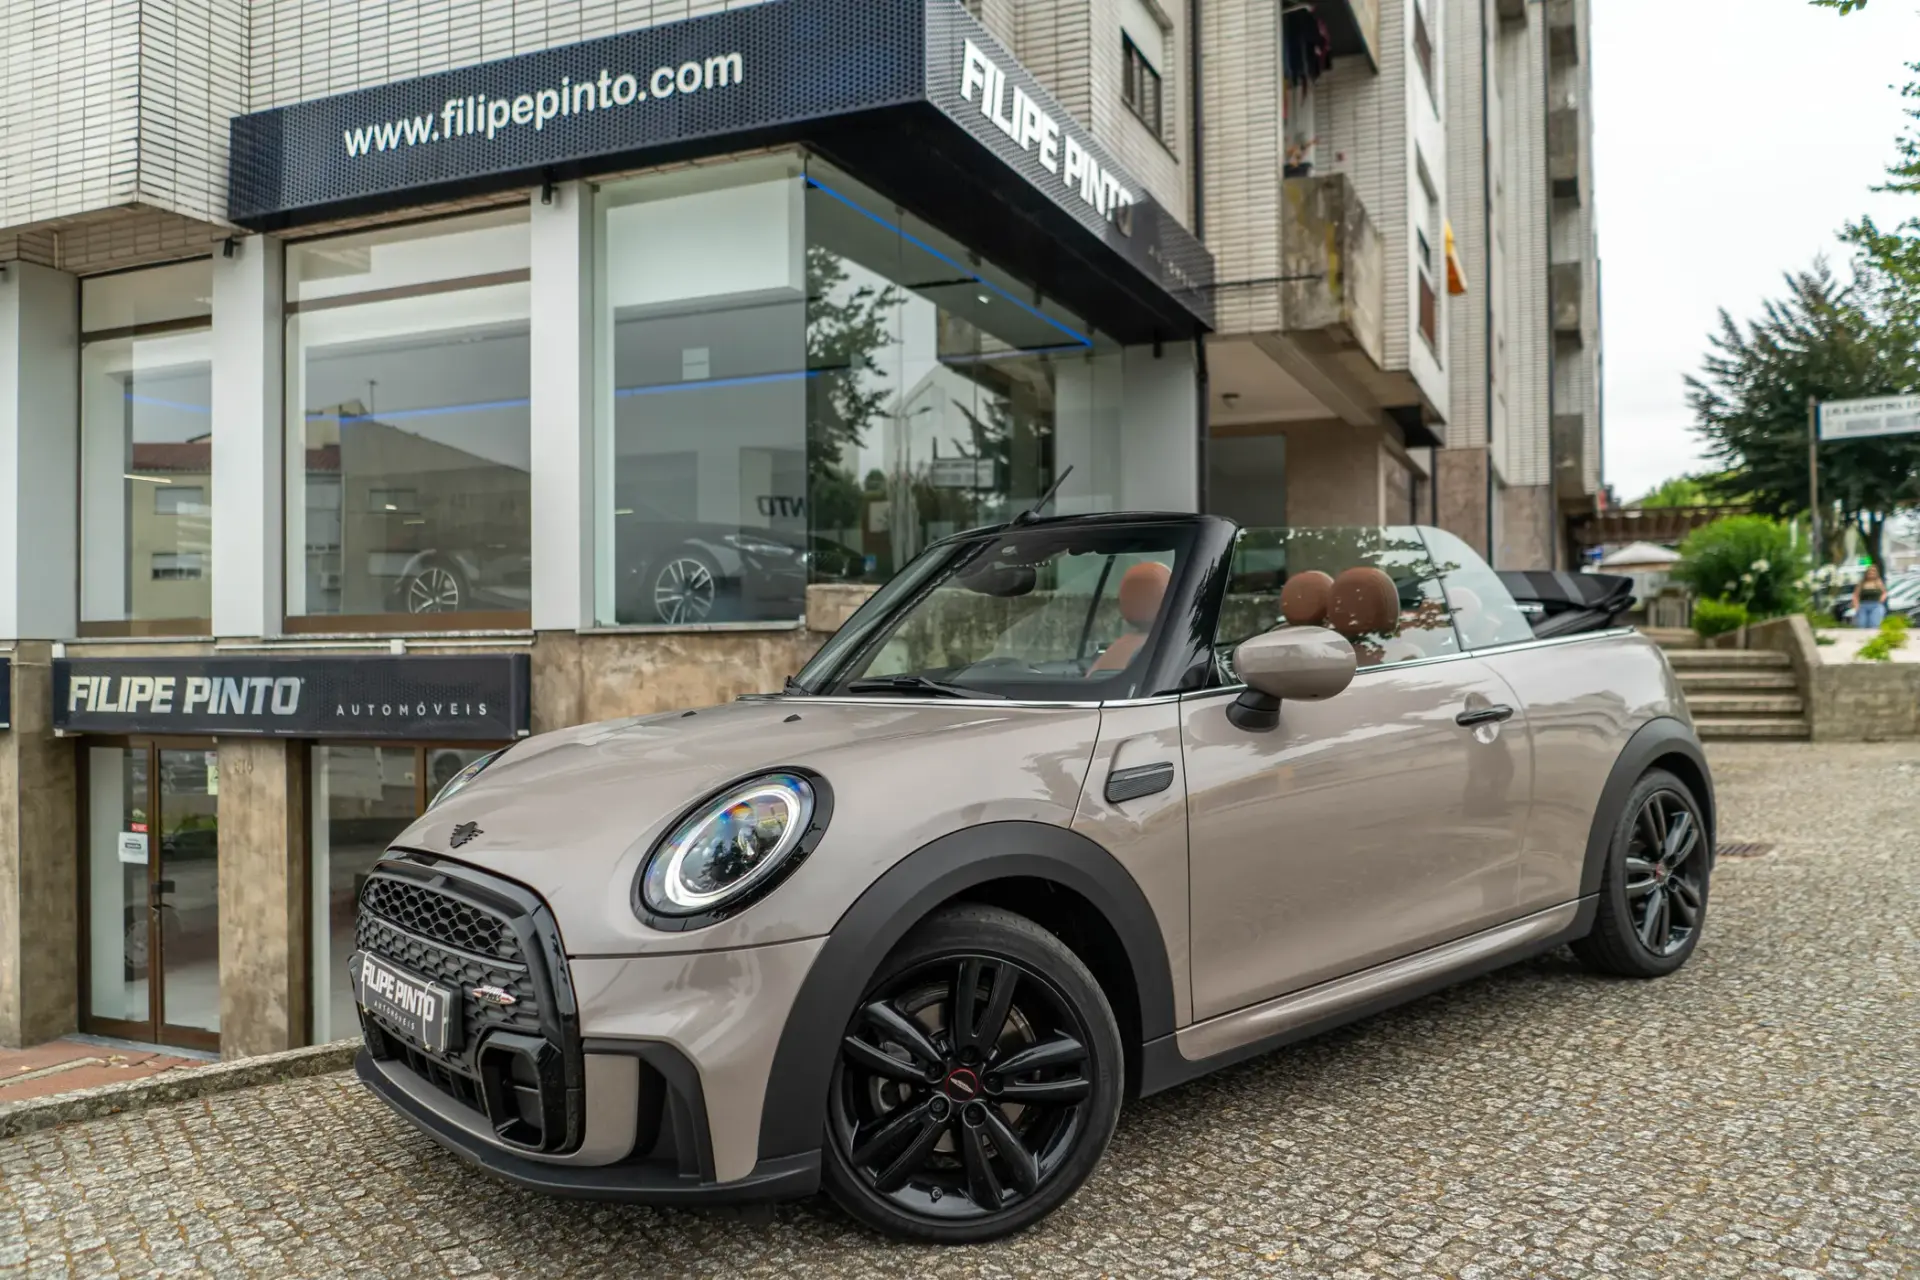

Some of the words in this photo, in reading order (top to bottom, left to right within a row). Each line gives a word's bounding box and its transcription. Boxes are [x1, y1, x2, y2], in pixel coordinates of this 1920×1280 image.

[344, 51, 743, 157] www.filipepinto.com
[960, 38, 1060, 175] FILIPE
[1063, 134, 1134, 238] PINTO
[68, 676, 176, 713] FILIPE
[183, 676, 301, 715] PINTO
[336, 702, 487, 716] AUTOMÓVEIS
[361, 960, 396, 1000] FILIPE
[395, 980, 436, 1022] PINTO
